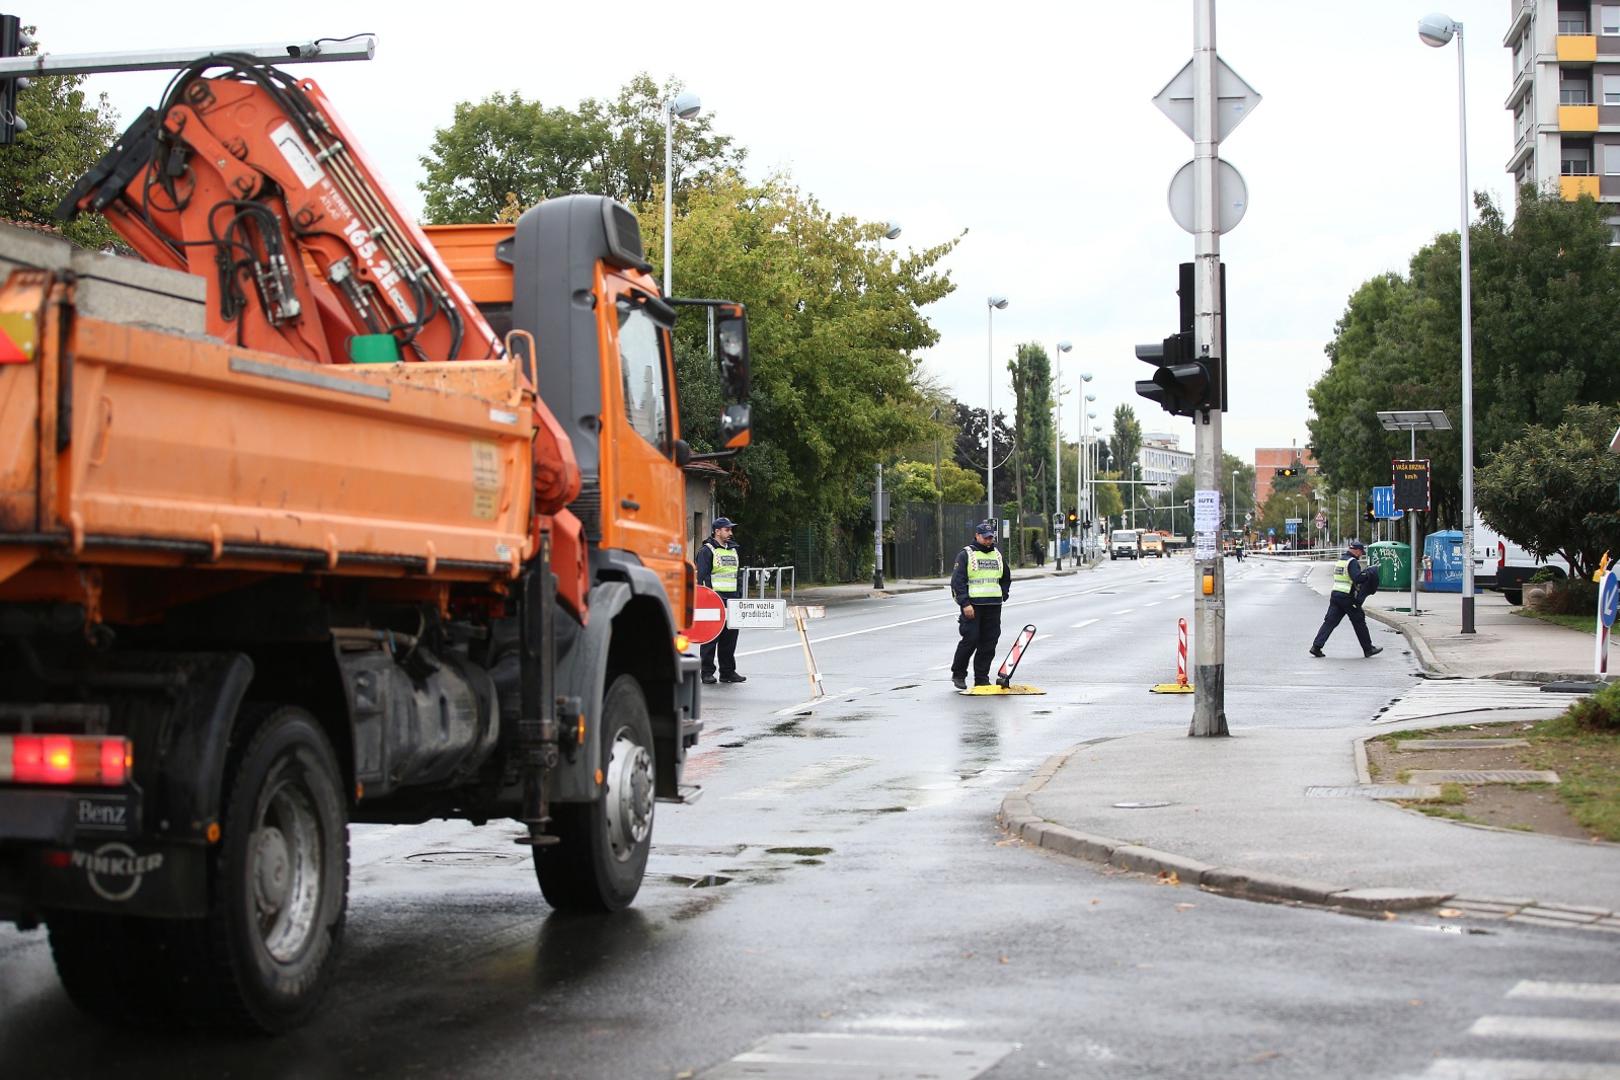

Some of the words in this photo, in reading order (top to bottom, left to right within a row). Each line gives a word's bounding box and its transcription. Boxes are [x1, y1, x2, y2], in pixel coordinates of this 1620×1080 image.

[328, 186, 353, 219] TEREX
[343, 217, 401, 291] 165.2E
[738, 602, 754, 610] Osim
[741, 611, 772, 620] gradilišta
[79, 799, 126, 824] Benz
